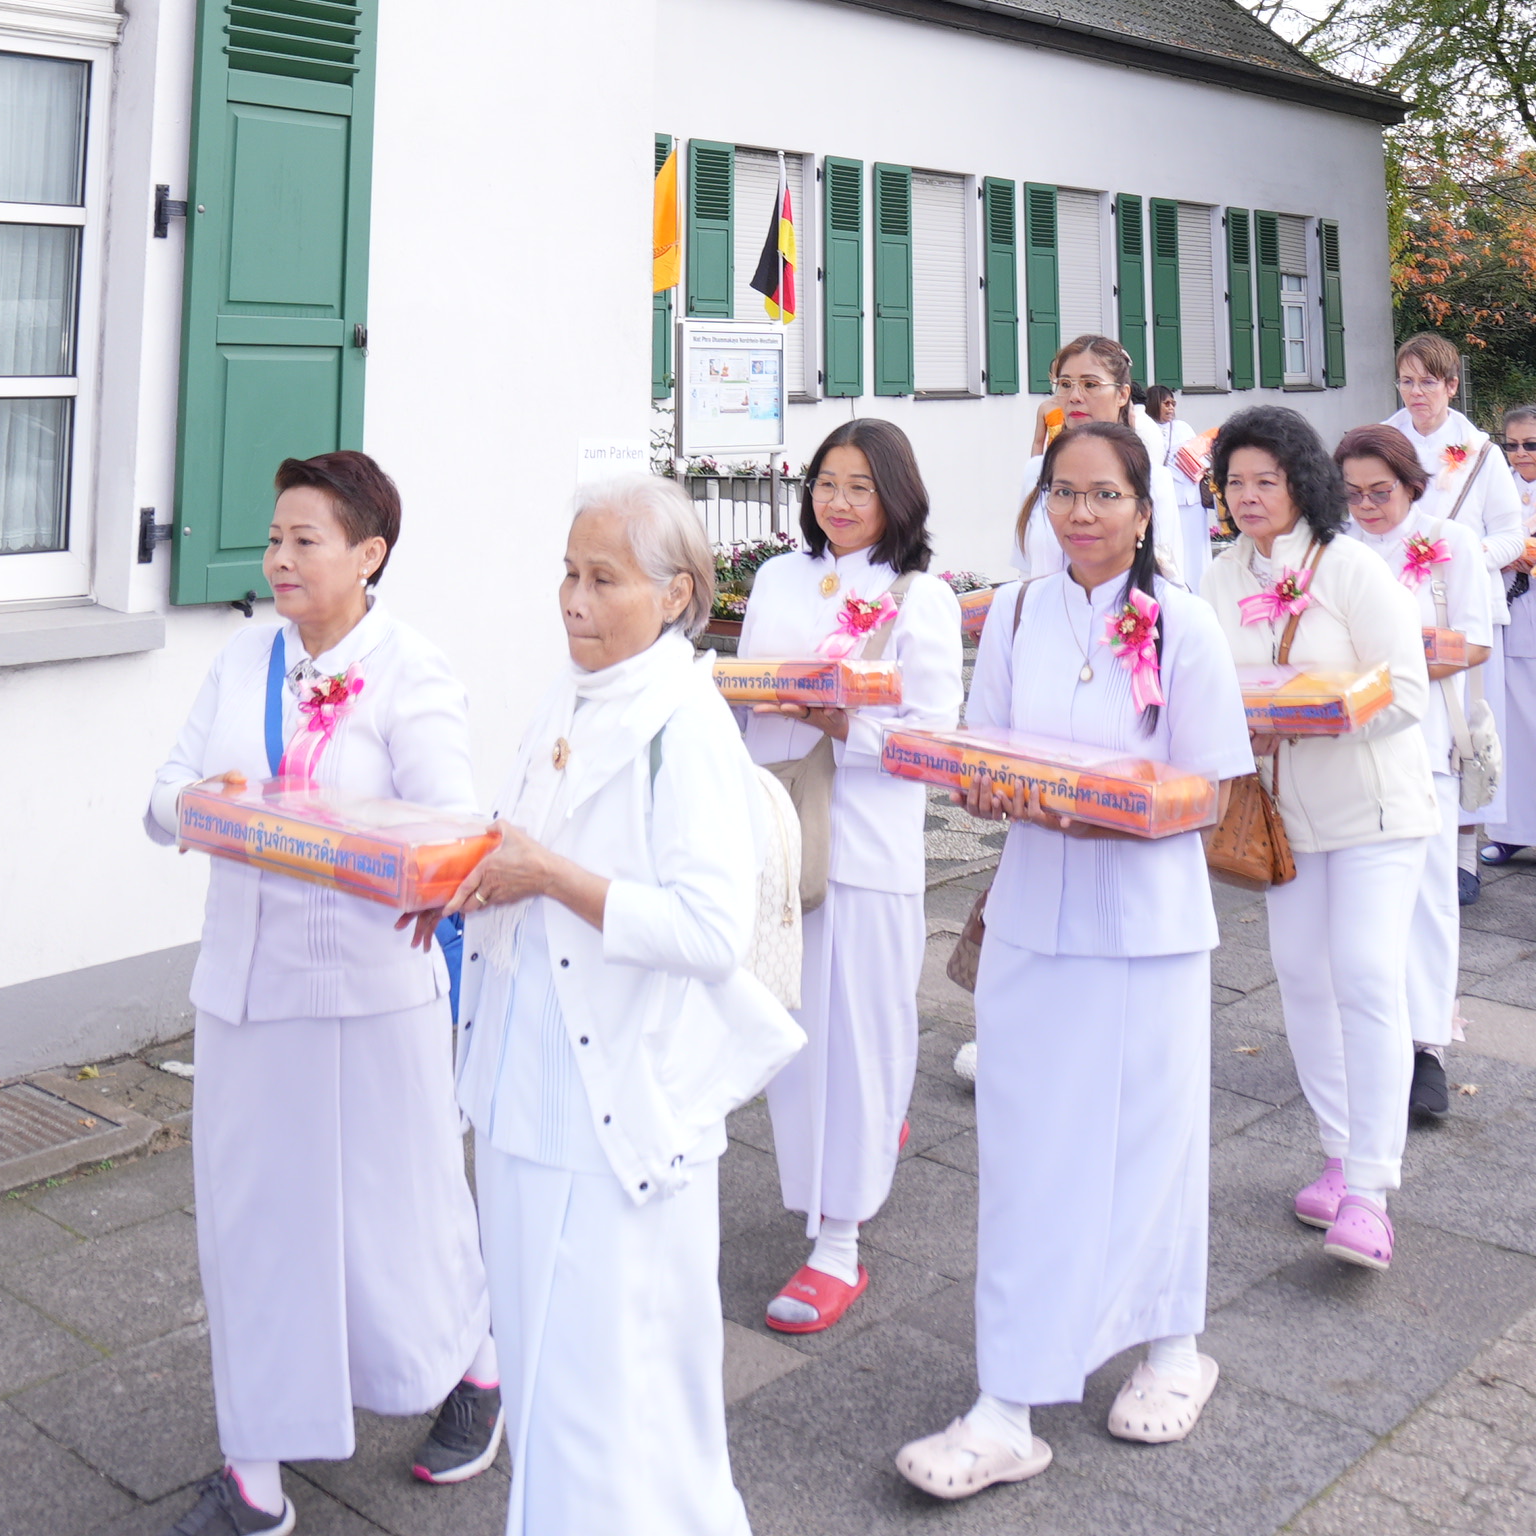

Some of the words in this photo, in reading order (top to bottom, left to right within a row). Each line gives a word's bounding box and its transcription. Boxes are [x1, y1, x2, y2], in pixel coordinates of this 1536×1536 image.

[584, 448, 606, 459] zum
[609, 445, 644, 460] Parken
[714, 670, 835, 691] จักรพรรดิมหาสมบัติ
